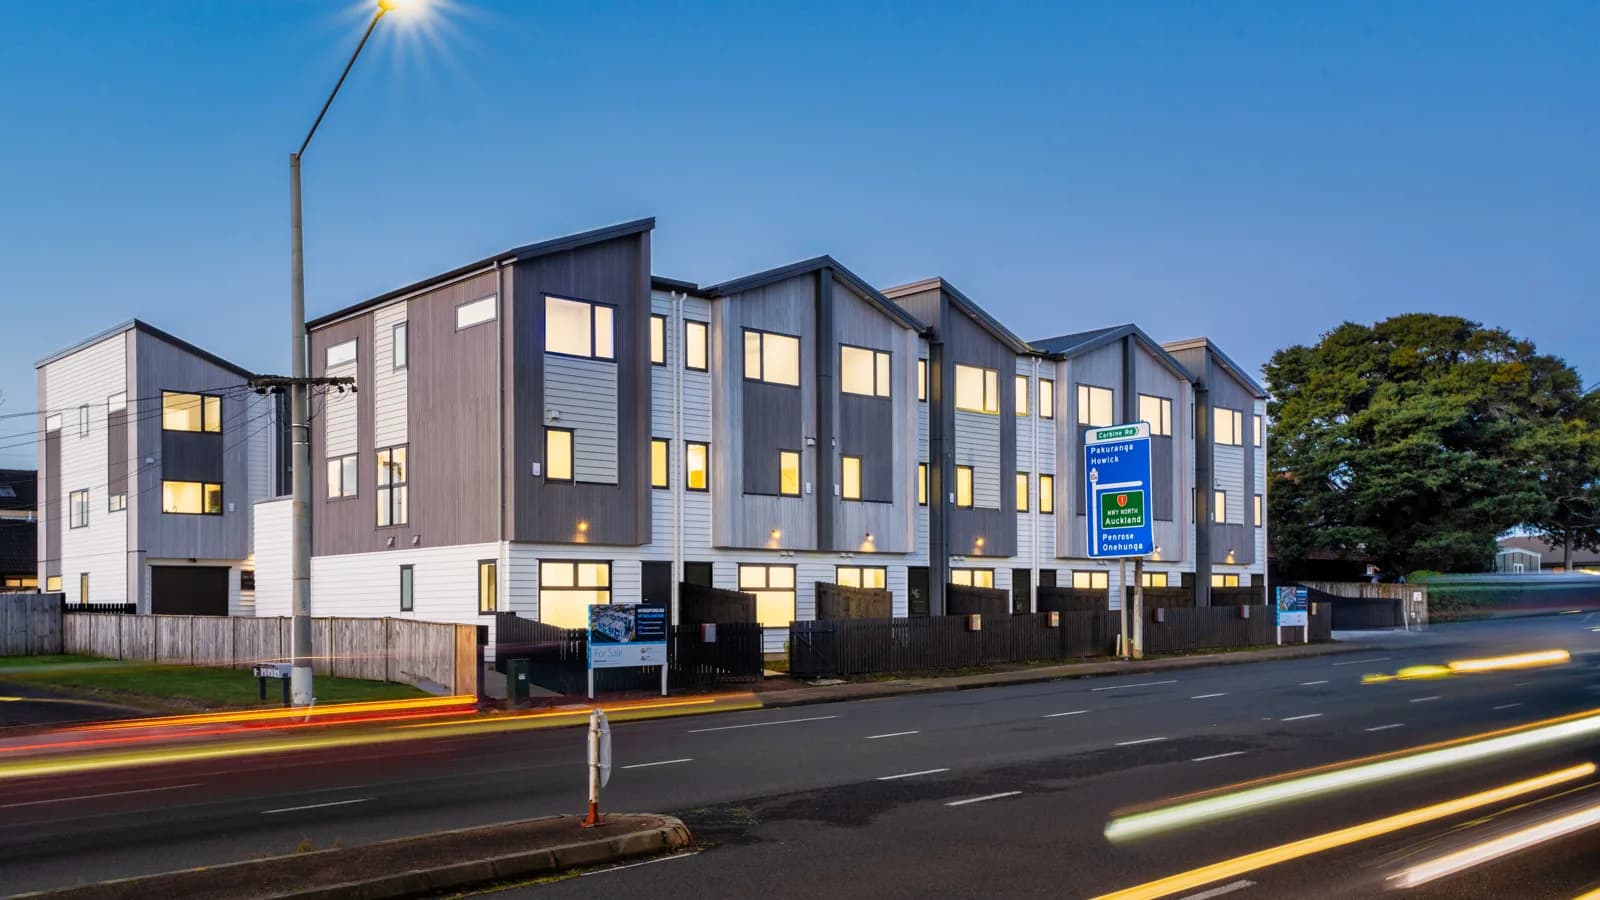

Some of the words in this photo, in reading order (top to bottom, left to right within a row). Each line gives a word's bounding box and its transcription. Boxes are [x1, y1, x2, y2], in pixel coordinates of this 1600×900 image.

[1098, 430, 1122, 439] Carbine
[1091, 444, 1134, 454] Pakuranga
[1091, 456, 1119, 465] Howick
[1105, 516, 1141, 526] Auckland
[1103, 533, 1134, 541] Penrose
[1103, 543, 1143, 551] Onehunga
[594, 648, 605, 658] For
[608, 647, 623, 657] Sale
